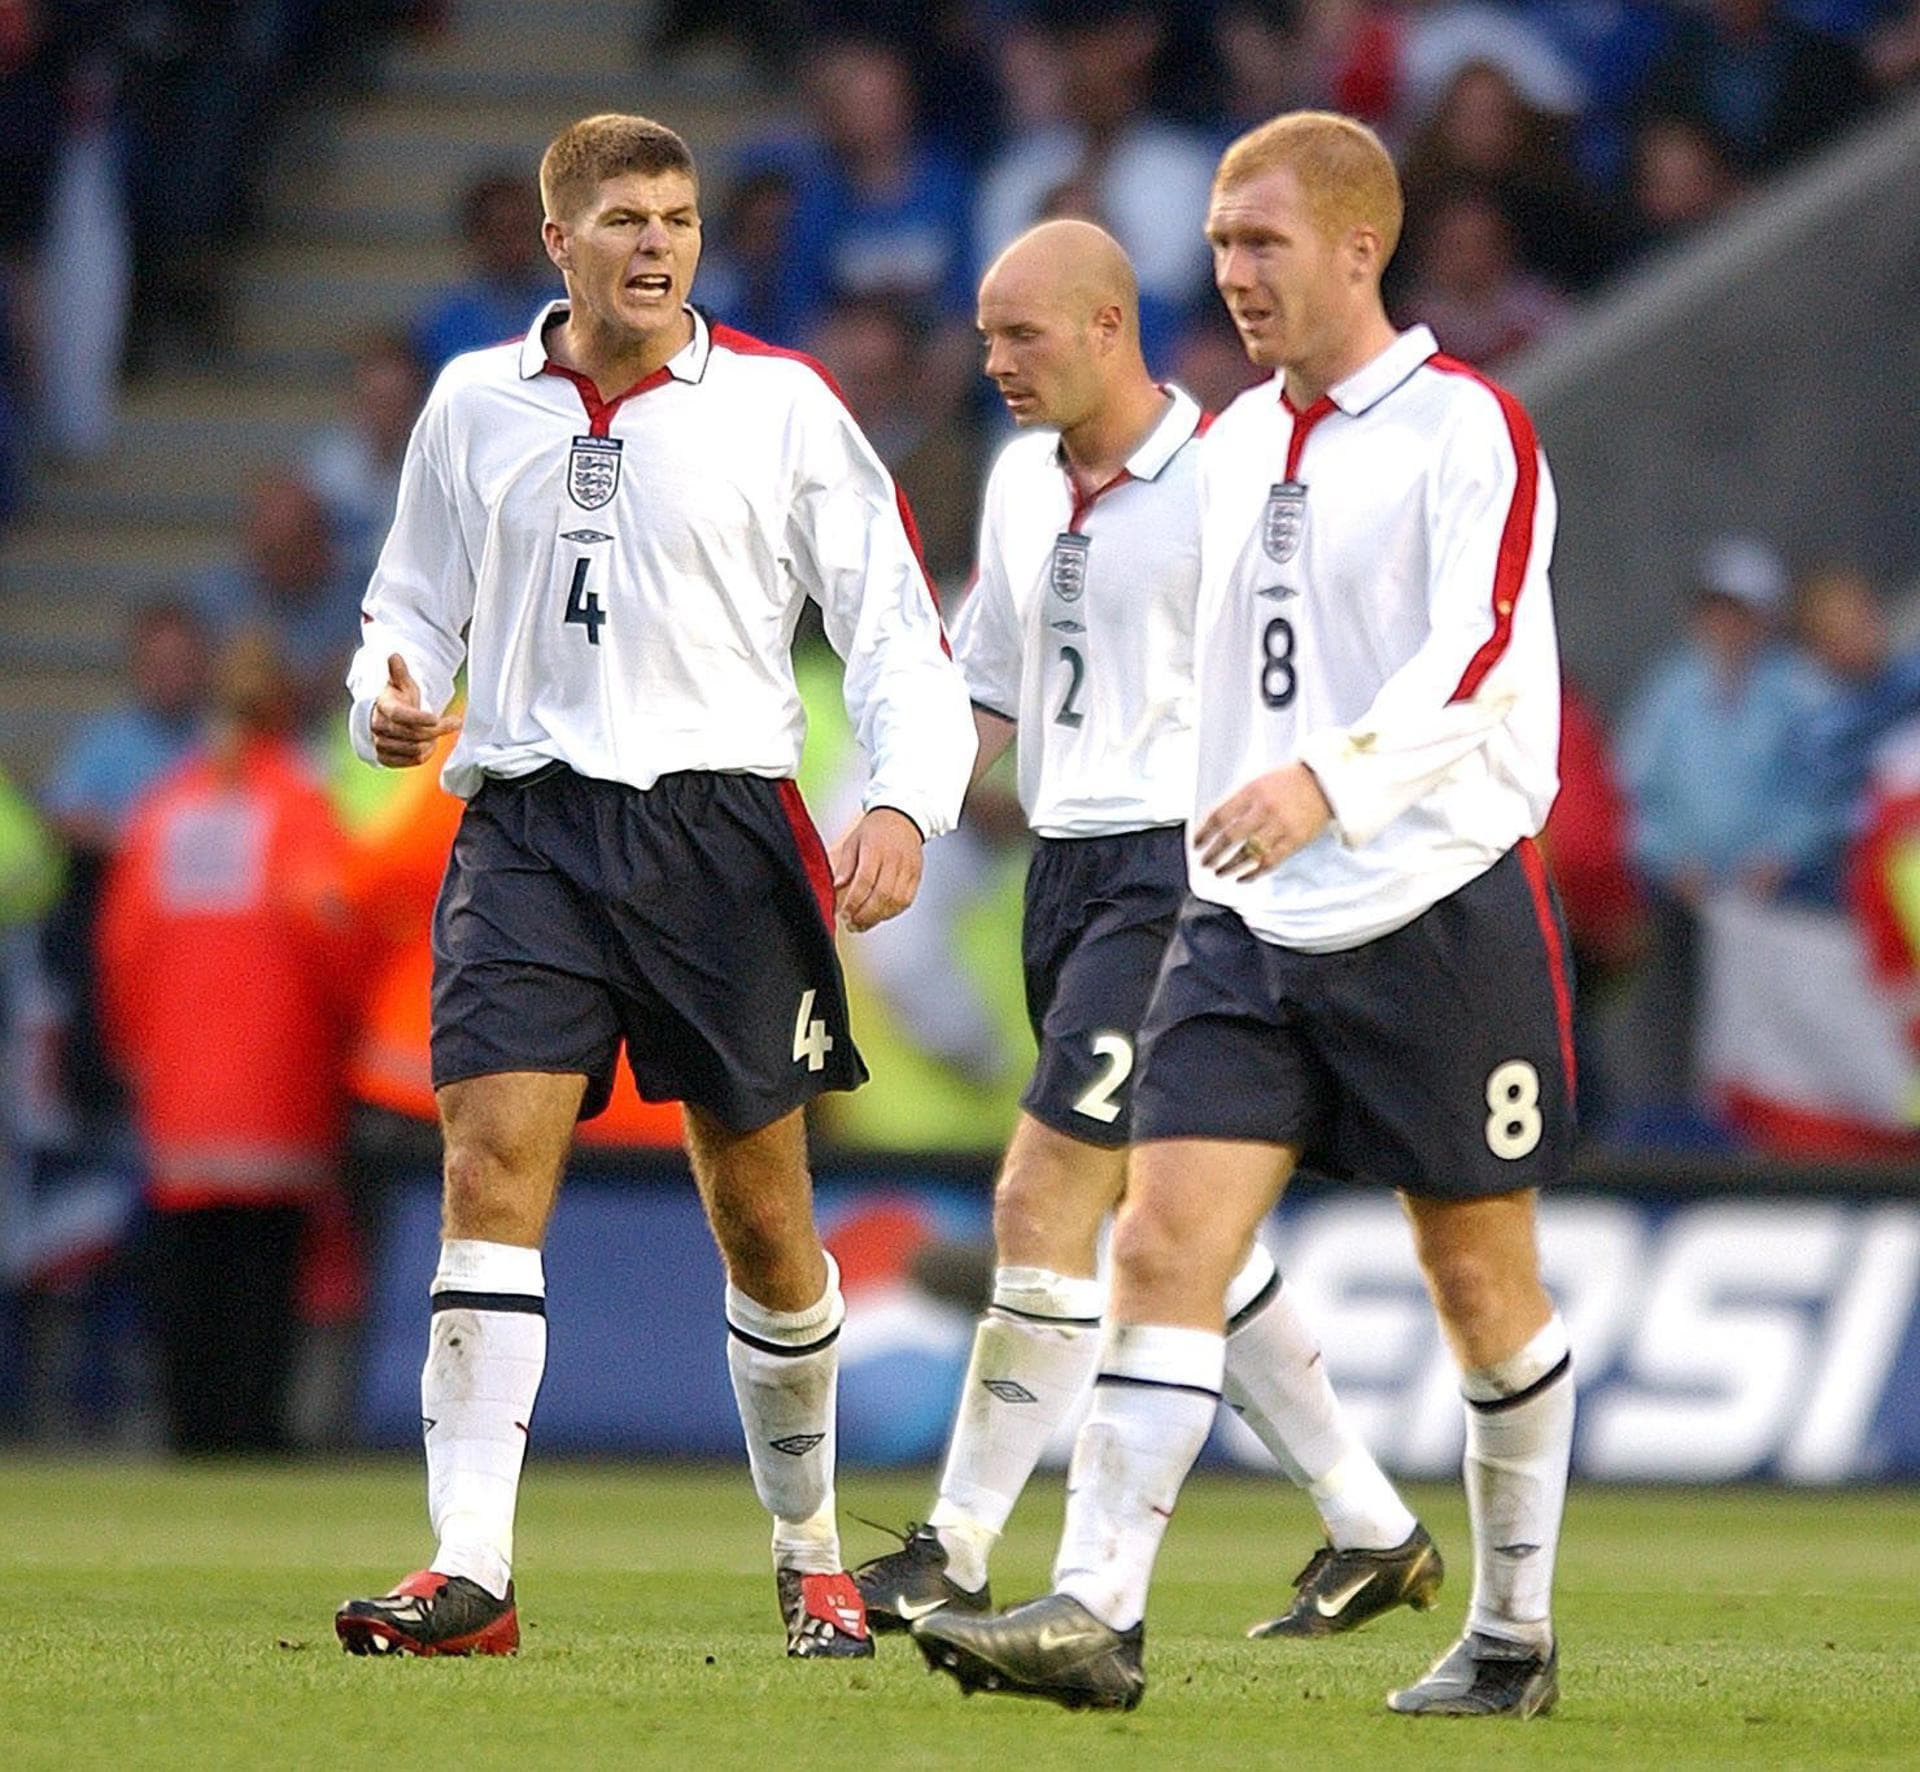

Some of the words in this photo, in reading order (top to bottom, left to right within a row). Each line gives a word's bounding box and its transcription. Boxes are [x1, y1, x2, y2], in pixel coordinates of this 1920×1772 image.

[565, 558, 606, 645] 4
[1054, 645, 1085, 728] 2
[1262, 617, 1297, 709] 8
[793, 988, 833, 1072] 4
[1073, 1036, 1134, 1123] 2
[1486, 1061, 1543, 1160] 8
[1038, 1196, 1918, 1479] EPSI
